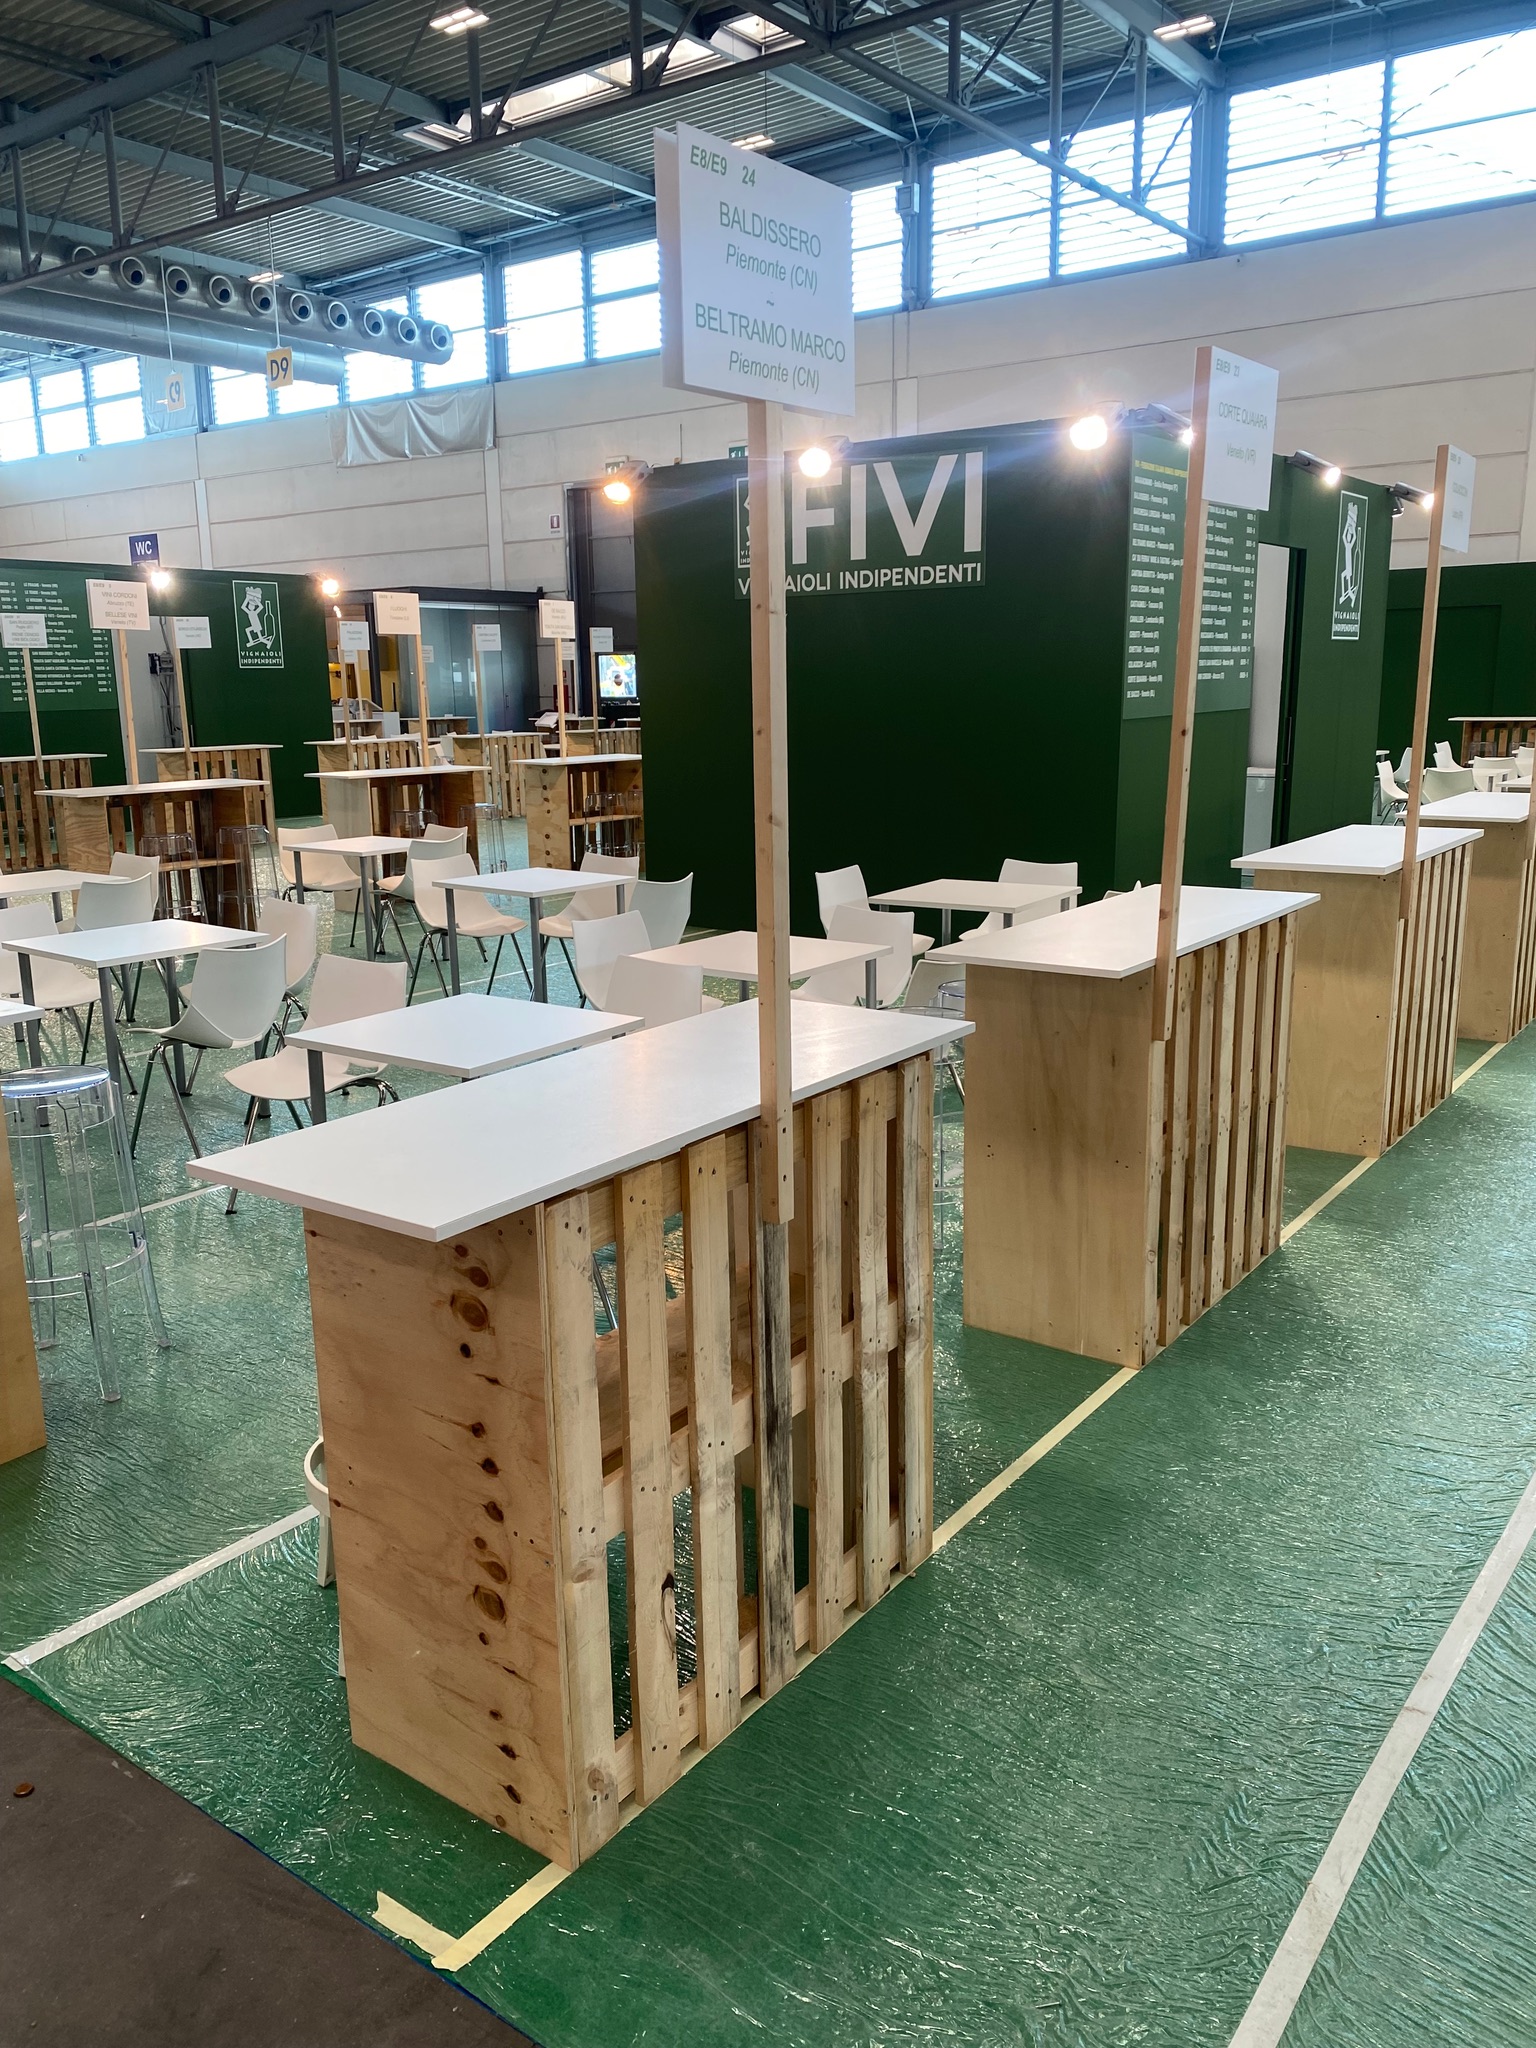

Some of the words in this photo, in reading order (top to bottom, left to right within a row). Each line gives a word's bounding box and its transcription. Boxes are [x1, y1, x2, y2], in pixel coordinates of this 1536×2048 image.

[690, 145, 728, 176] E8/E9
[742, 166, 756, 187] 24
[719, 201, 821, 257] BALDISSERO
[726, 243, 786, 282] Piemonte
[790, 264, 818, 296] (CN)
[695, 303, 787, 348] BELTRAMO
[791, 328, 846, 363] MARCO
[270, 357, 289, 382] D9
[729, 351, 789, 383] Piemonte
[792, 365, 820, 394] (CN)
[169, 381, 180, 403] C9
[1219, 402, 1241, 422] CORTE
[1242, 408, 1268, 430] QUAIARA
[1227, 442, 1244, 460] Veneto
[792, 451, 983, 565] FIVI
[135, 541, 152, 556] WC
[738, 573, 831, 596] VAIOLI
[839, 562, 982, 590] INDIPENDENTI
[1335, 612, 1360, 620] VIGNAIOLI
